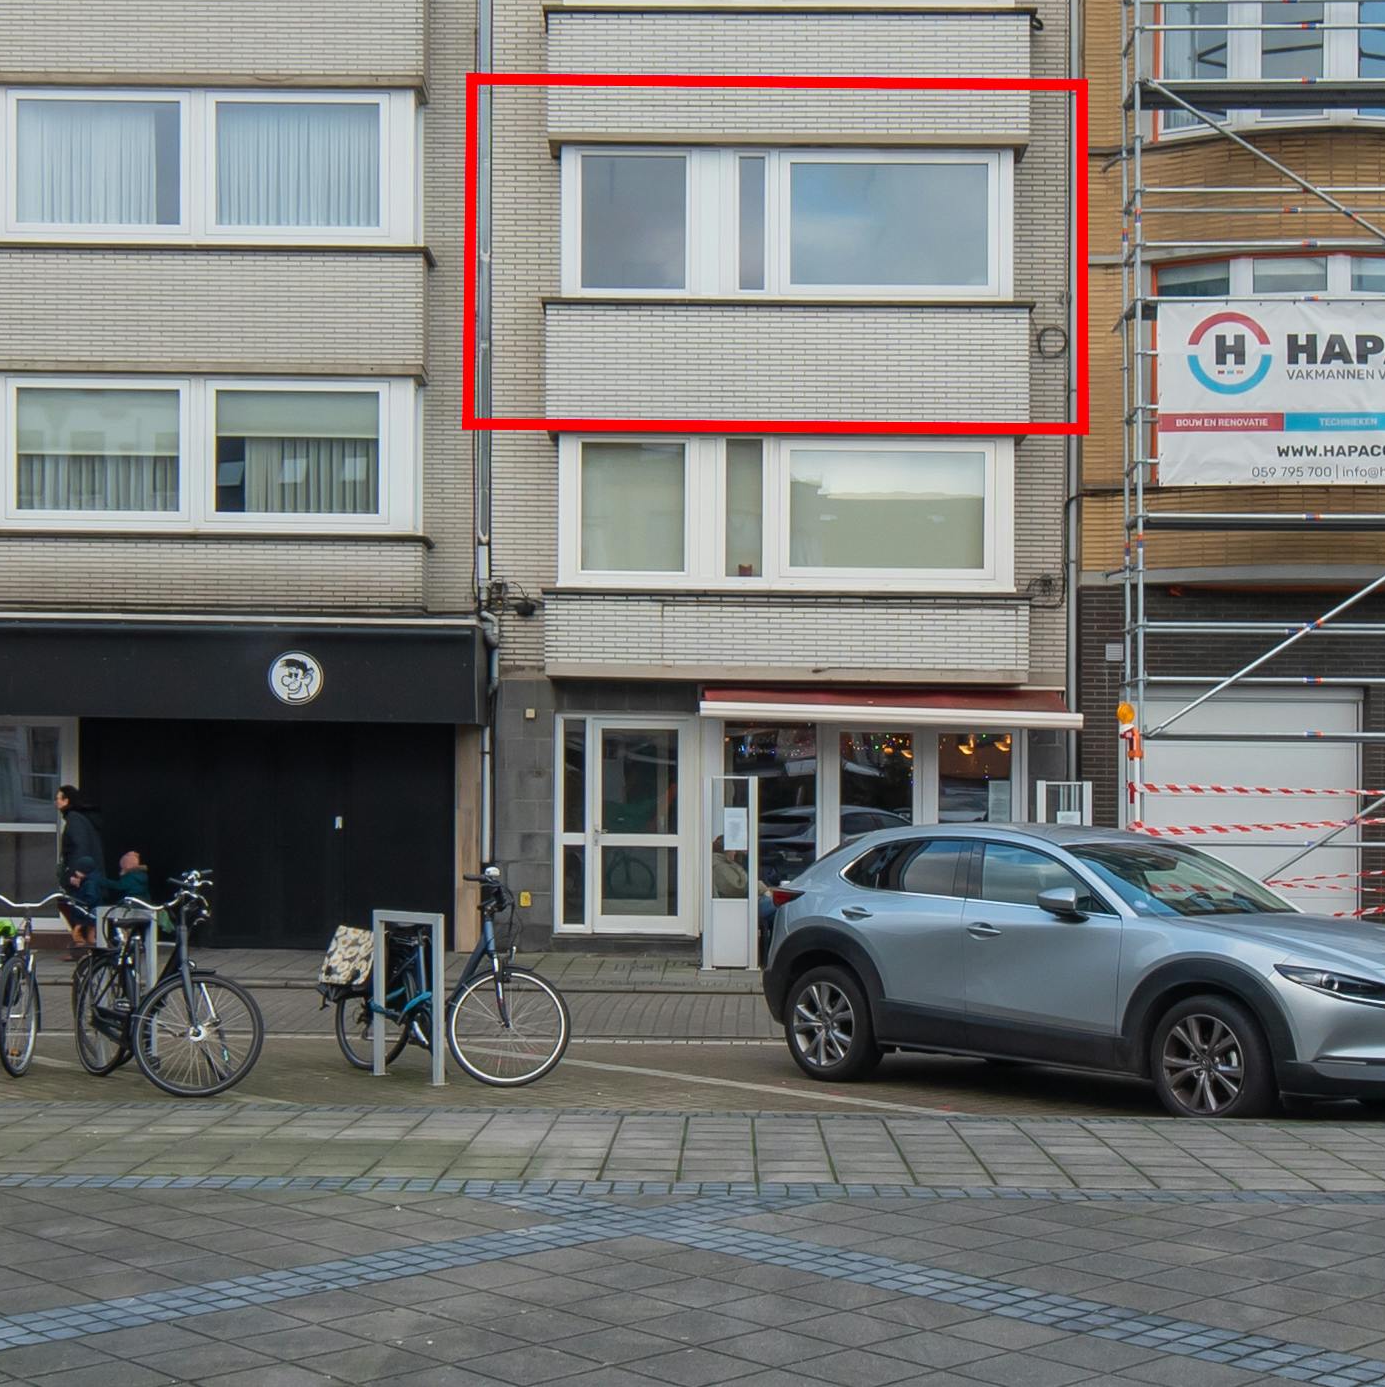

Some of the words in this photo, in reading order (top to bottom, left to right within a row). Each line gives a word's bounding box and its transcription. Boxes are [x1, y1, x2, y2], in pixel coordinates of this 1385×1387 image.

[1216, 334, 1245, 366] H
[1286, 369, 1375, 380] VAKMANNEN
[1175, 418, 1202, 427] BOUW
[1204, 418, 1216, 427] EN
[1218, 418, 1269, 427] RENOVATIE
[1251, 466, 1276, 478] 059
[1282, 466, 1304, 478] 795
[1308, 466, 1332, 478] 700
